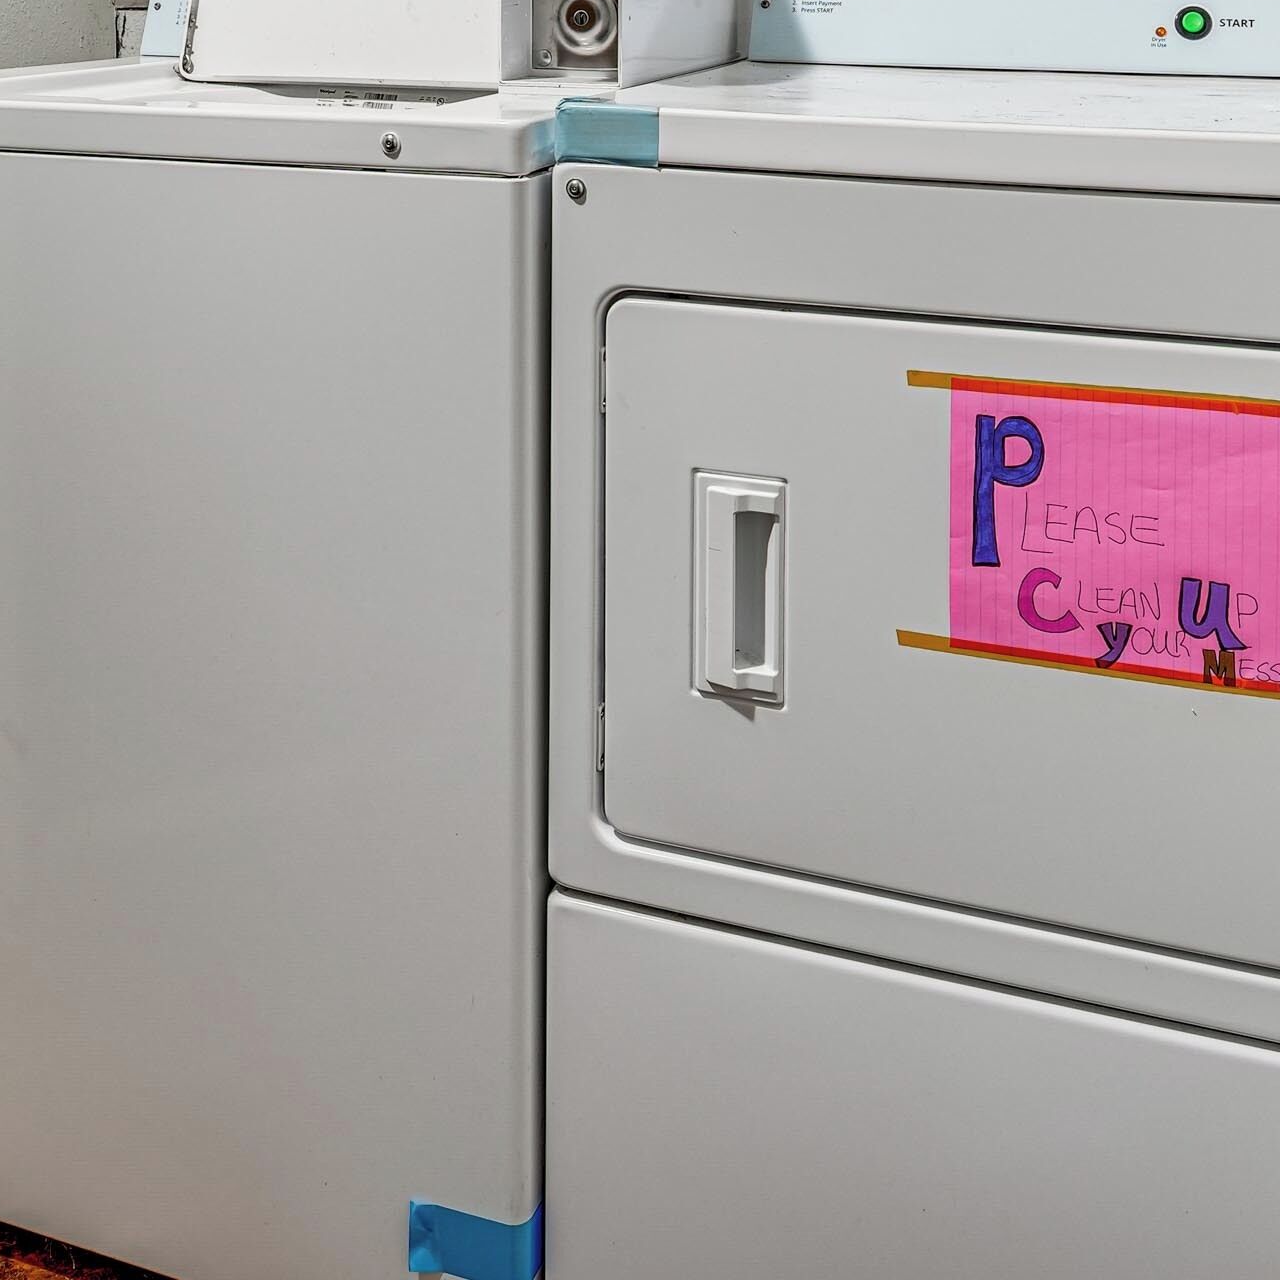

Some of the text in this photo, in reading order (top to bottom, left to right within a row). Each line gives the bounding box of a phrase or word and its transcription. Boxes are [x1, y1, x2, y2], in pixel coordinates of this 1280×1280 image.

[1219, 18, 1256, 28] START
[972, 414, 1165, 567] PLEASE
[1017, 567, 1260, 651] CLEAN UP
[1094, 621, 1191, 669] YOUR
